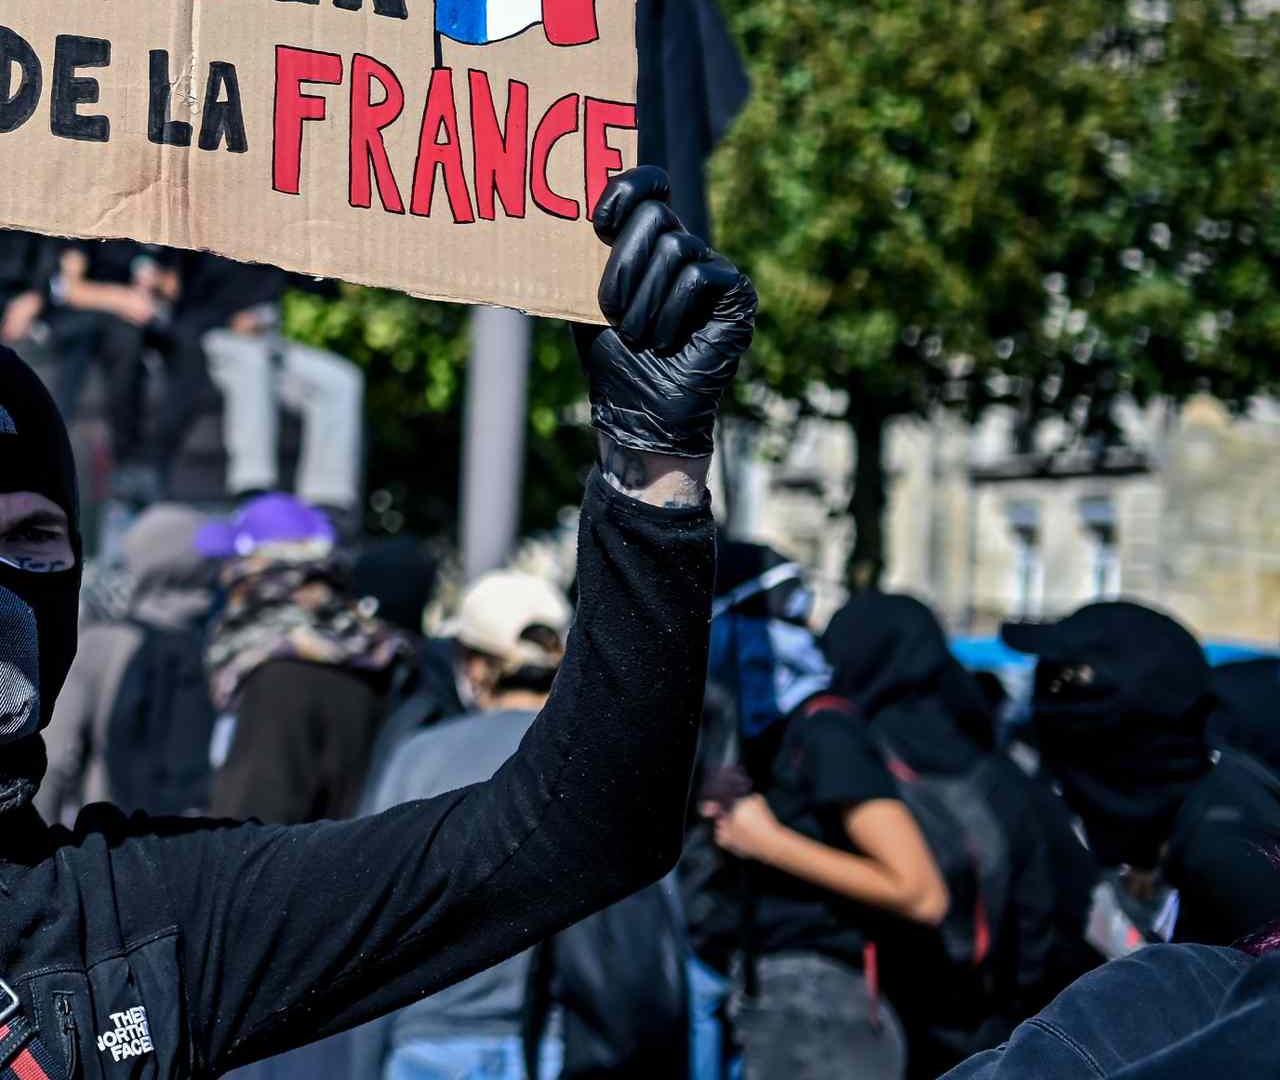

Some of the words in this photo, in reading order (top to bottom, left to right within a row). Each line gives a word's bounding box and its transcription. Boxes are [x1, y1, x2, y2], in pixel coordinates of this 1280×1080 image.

[148, 50, 248, 153] LA
[272, 45, 638, 224] FRANCE
[109, 1007, 143, 1028] THE
[111, 1036, 150, 1062] FACE
